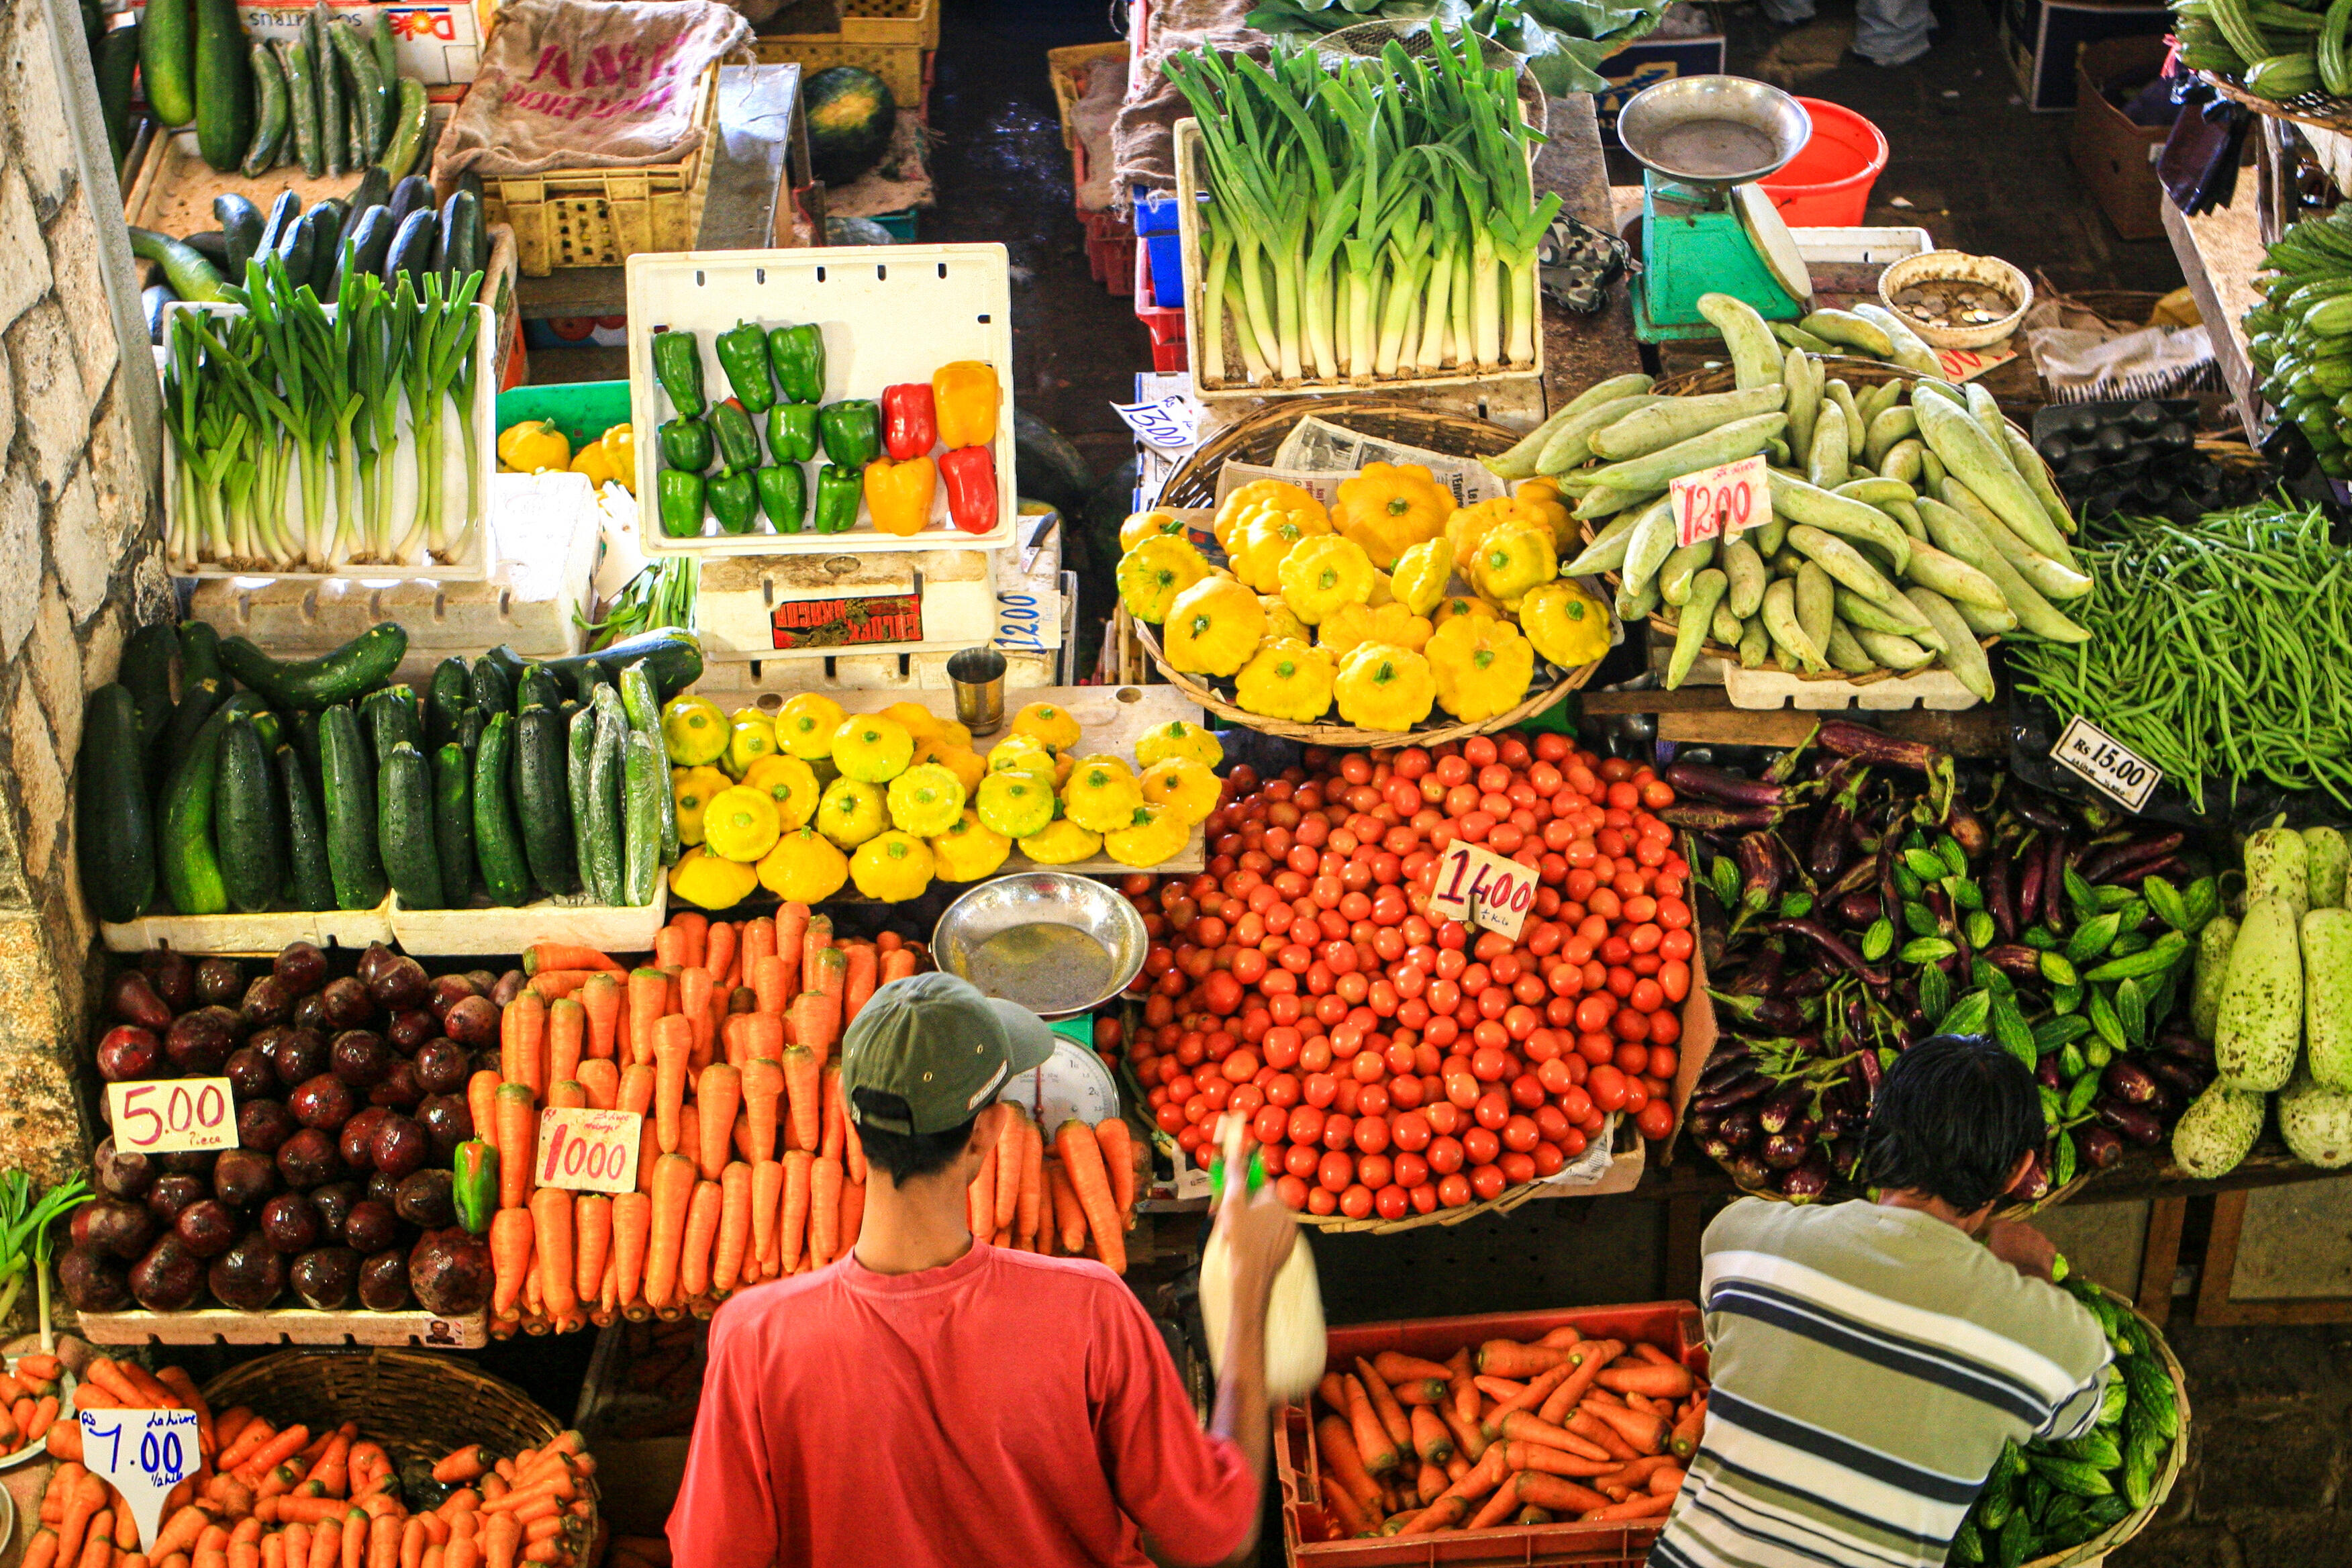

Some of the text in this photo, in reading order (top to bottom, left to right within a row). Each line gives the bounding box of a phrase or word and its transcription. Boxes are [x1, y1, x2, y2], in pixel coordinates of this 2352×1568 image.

[2073, 738, 2146, 787] Rs 15.00
[124, 1084, 225, 1146] 5.00
[88, 1423, 183, 1473] 7.00
